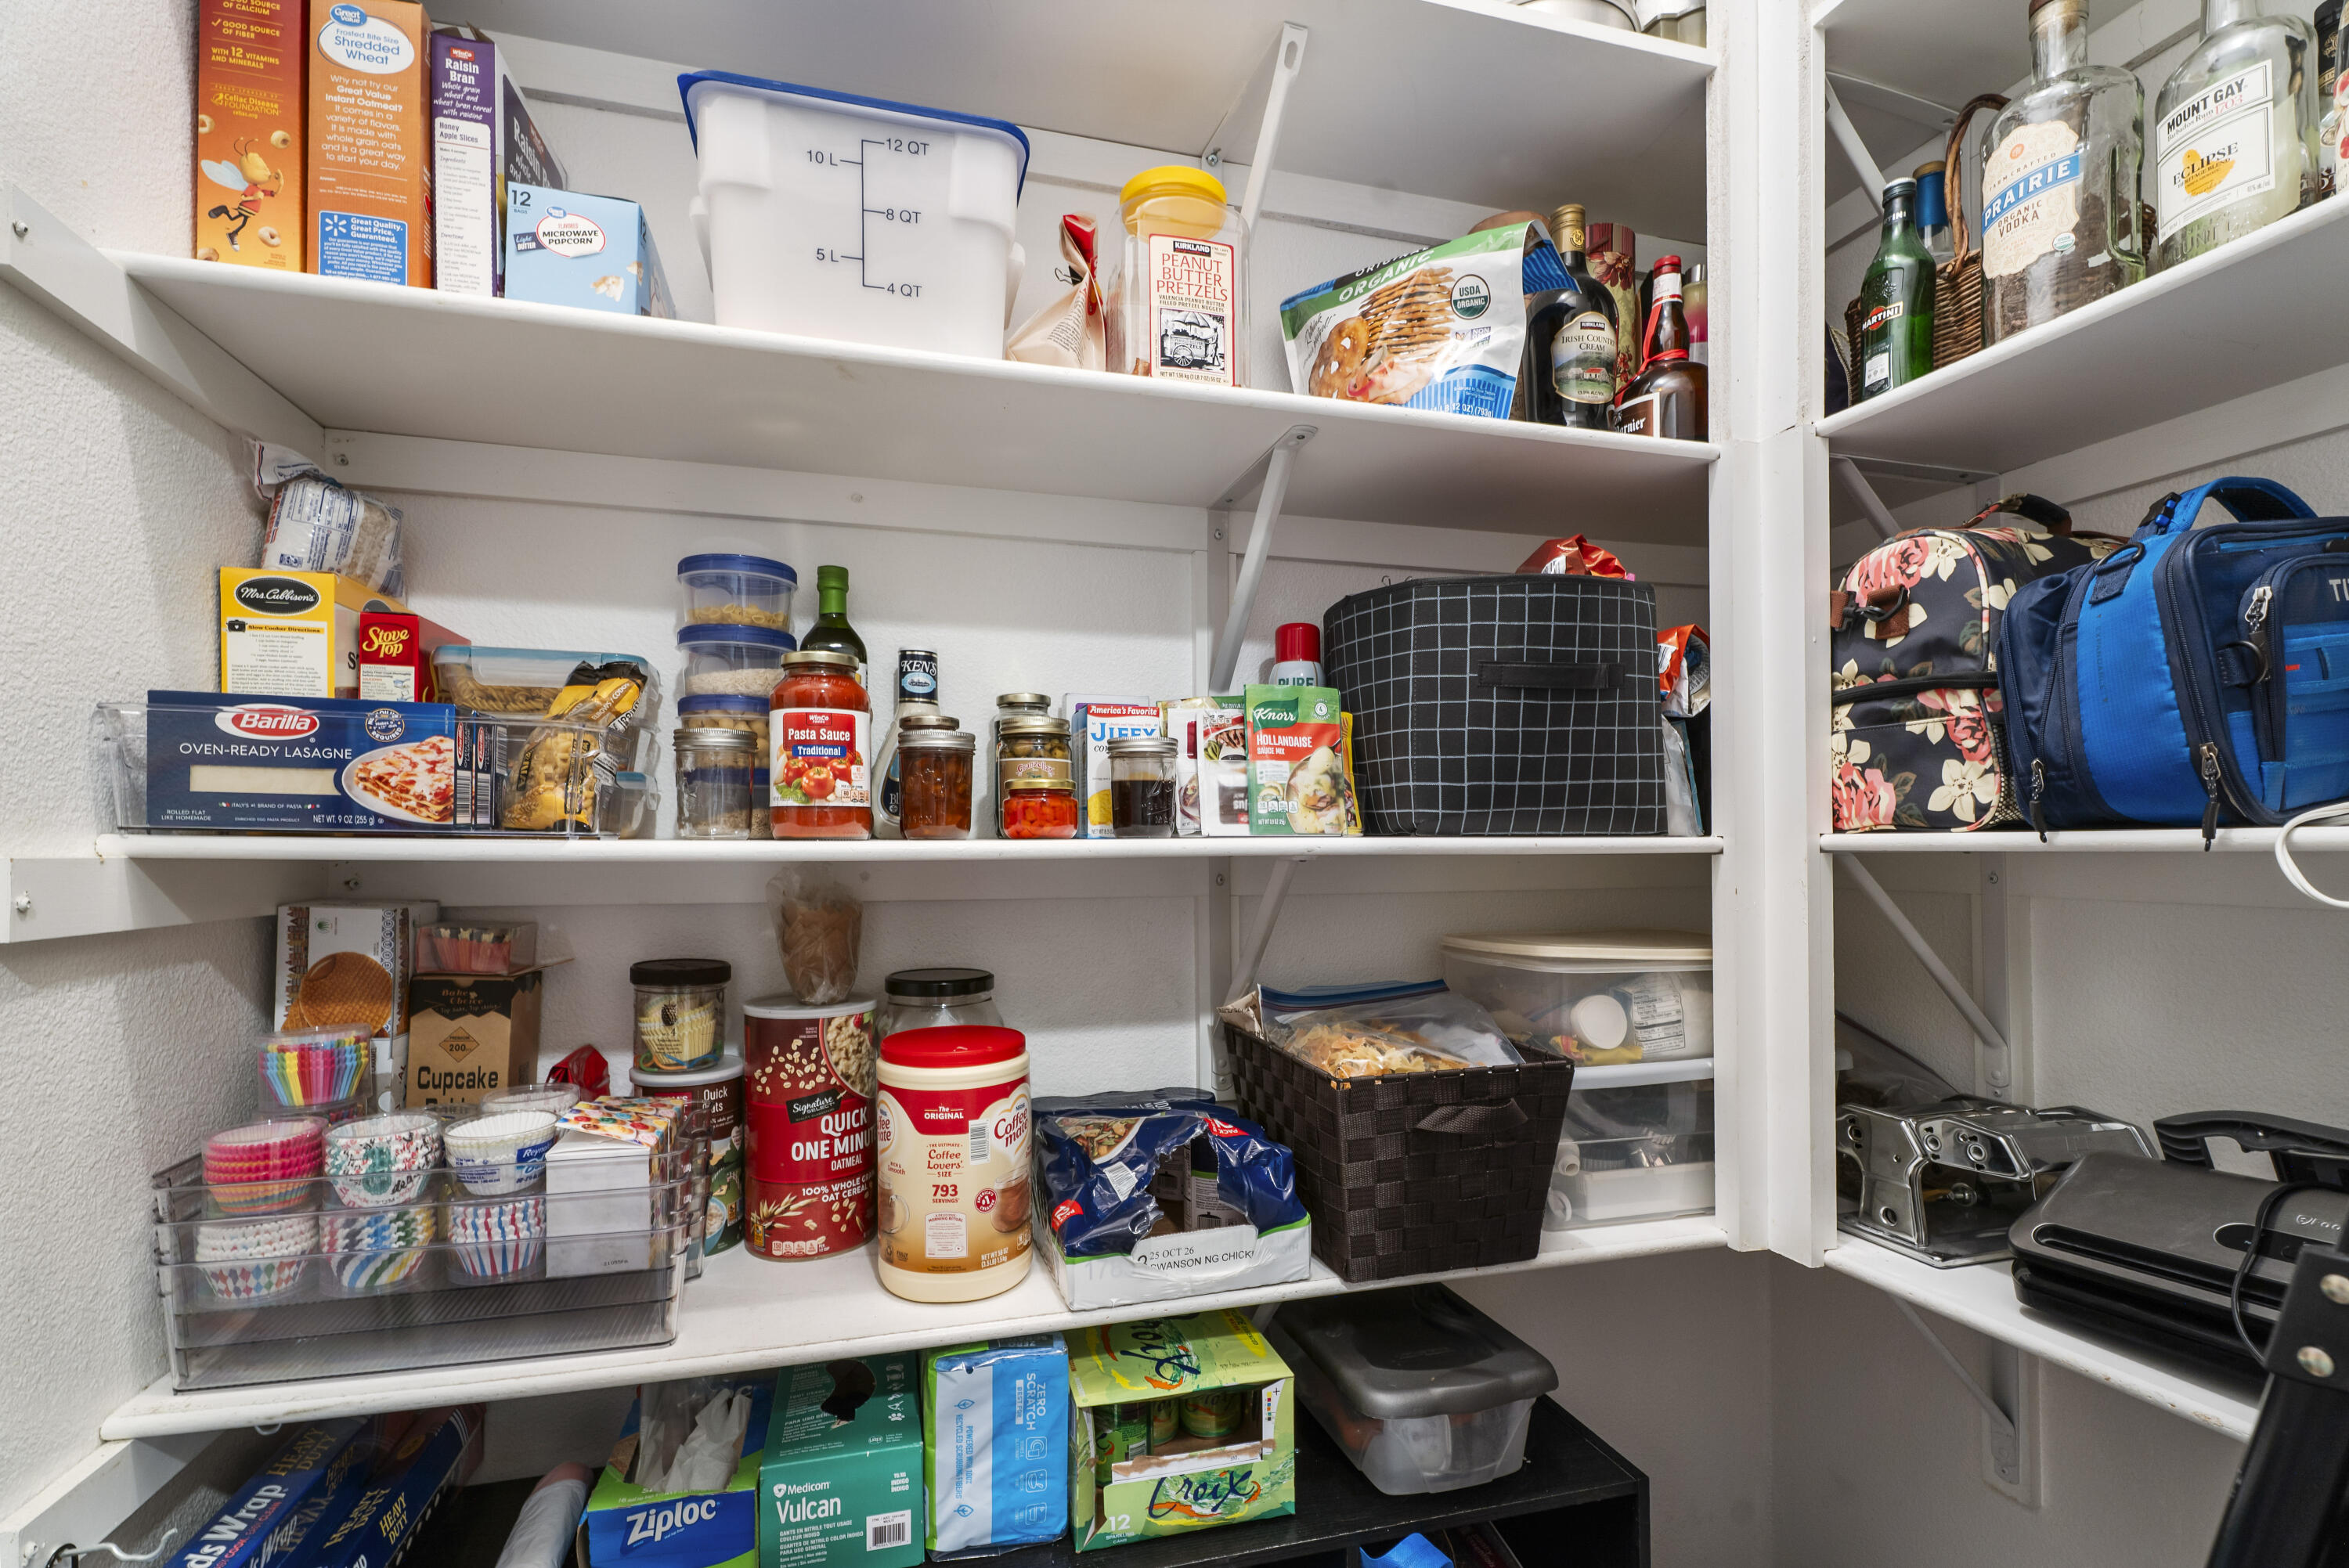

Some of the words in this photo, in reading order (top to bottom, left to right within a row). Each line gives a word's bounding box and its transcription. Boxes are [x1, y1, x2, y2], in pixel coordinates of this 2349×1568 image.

[236, 3, 269, 15] CALCIUM
[223, 20, 247, 30] GOOD
[251, 25, 280, 37] SOURCE
[337, 28, 365, 38] Frosted
[367, 33, 381, 41] Bite
[335, 35, 399, 55] Shredded
[231, 46, 244, 57] 12
[246, 52, 280, 64] VITAMINS
[345, 49, 388, 64] Wheat
[229, 58, 264, 69] MINERALS
[446, 58, 479, 74] Raisin
[330, 74, 349, 85] Why
[450, 70, 475, 85] Bran
[337, 85, 363, 96] Great
[365, 89, 392, 100] Value
[326, 94, 354, 104] Instant
[357, 99, 402, 113] Oatmeal?
[2167, 96, 2209, 135] MOUNT
[2214, 78, 2244, 103] GAY
[439, 121, 460, 132] Honey
[2167, 121, 2195, 142] Barbados
[2215, 95, 2243, 115] 1703
[440, 131, 457, 142] Apple
[460, 133, 478, 143] Slices
[886, 139, 902, 152] 12
[908, 141, 929, 156] QT
[807, 150, 824, 164] 10
[830, 153, 838, 166] L
[2174, 142, 2239, 185] ECLIPSE
[2178, 168, 2206, 188] HERITAGE
[2208, 158, 2231, 171] BLEND
[1989, 175, 2008, 190] FARM
[511, 189, 531, 207] 12
[1984, 160, 2071, 227] PRAIRIE
[886, 208, 894, 221] 8
[900, 210, 922, 224] QT
[1997, 200, 2042, 227] ORGANIC
[373, 220, 403, 232] Quality.
[373, 228, 394, 236] Price.
[2000, 211, 2039, 237] VODKA
[351, 231, 398, 243] Guaranteed.
[817, 248, 825, 261] 5
[831, 250, 839, 262] L
[1174, 242, 1210, 253] KIRKLAND
[1162, 253, 1222, 273] PEANUT
[1163, 267, 1221, 287] BUTTER
[1339, 251, 1434, 302] ORGANIC
[887, 283, 895, 294] 4
[900, 284, 922, 297] QT
[1156, 279, 1228, 301] PRETZELS
[1460, 286, 1481, 297] USDA
[1457, 298, 1485, 308] ORGANIC
[1862, 308, 1900, 330] MARTINI
[1561, 336, 1584, 344] IRISH
[1586, 333, 1615, 346] COUNTRY
[1579, 342, 1605, 352] CREAM
[240, 587, 265, 600] Mrs.
[265, 589, 315, 602] Cubbison's
[363, 627, 410, 651] Stove
[379, 643, 403, 658] Top
[901, 660, 937, 676] KEN'S
[591, 701, 612, 720] ELBOWS
[1090, 705, 1126, 715] America's
[1128, 707, 1157, 716] Favorite
[1254, 708, 1296, 721] Knorr
[240, 713, 309, 731] Barilla
[788, 728, 816, 740] Pasta
[820, 728, 850, 741] Sauce
[1257, 734, 1312, 748] HOLLANDAISE
[179, 743, 280, 757] OVEN-READY
[285, 746, 352, 759] LASAGNE
[798, 745, 841, 755] Traditional
[313, 814, 325, 824] NET
[417, 1065, 499, 1095] Cupcake
[703, 1086, 728, 1101] Quick
[792, 1097, 834, 1115] Signature
[807, 1102, 835, 1113] SELECT
[821, 1106, 868, 1137] QUICK
[994, 1107, 1027, 1140] Coffee
[1005, 1119, 1028, 1147] mate
[791, 1140, 830, 1161] ONE
[929, 1148, 961, 1159] Coffee
[831, 1154, 862, 1171] OATMEAL
[802, 1186, 829, 1196] 100%
[832, 1177, 861, 1191] WHOLE
[822, 1192, 839, 1202] OAT
[842, 1184, 868, 1198] CEREAL
[932, 1184, 958, 1197] 793
[977, 1191, 994, 1203] AMERICA'S
[980, 1199, 995, 1211] CREAMER
[1163, 1249, 1182, 1257] OCT
[1185, 1246, 1194, 1255] 26
[1026, 1373, 1036, 1430] SCRATCH
[1037, 1382, 1046, 1417] ZERO
[266, 1427, 326, 1476] HEAVY
[296, 1435, 337, 1471] DUTY
[788, 1482, 830, 1495] Medicom
[1149, 1470, 1255, 1519] Croix
[199, 1483, 287, 1541] Wrap
[379, 1492, 406, 1537] HEAVY
[776, 1497, 841, 1524] Vulcan
[389, 1511, 407, 1545] DUTY
[626, 1499, 716, 1546] Ziploc
[1109, 1514, 1131, 1531] 12
[780, 1534, 803, 1543] COULEUR
